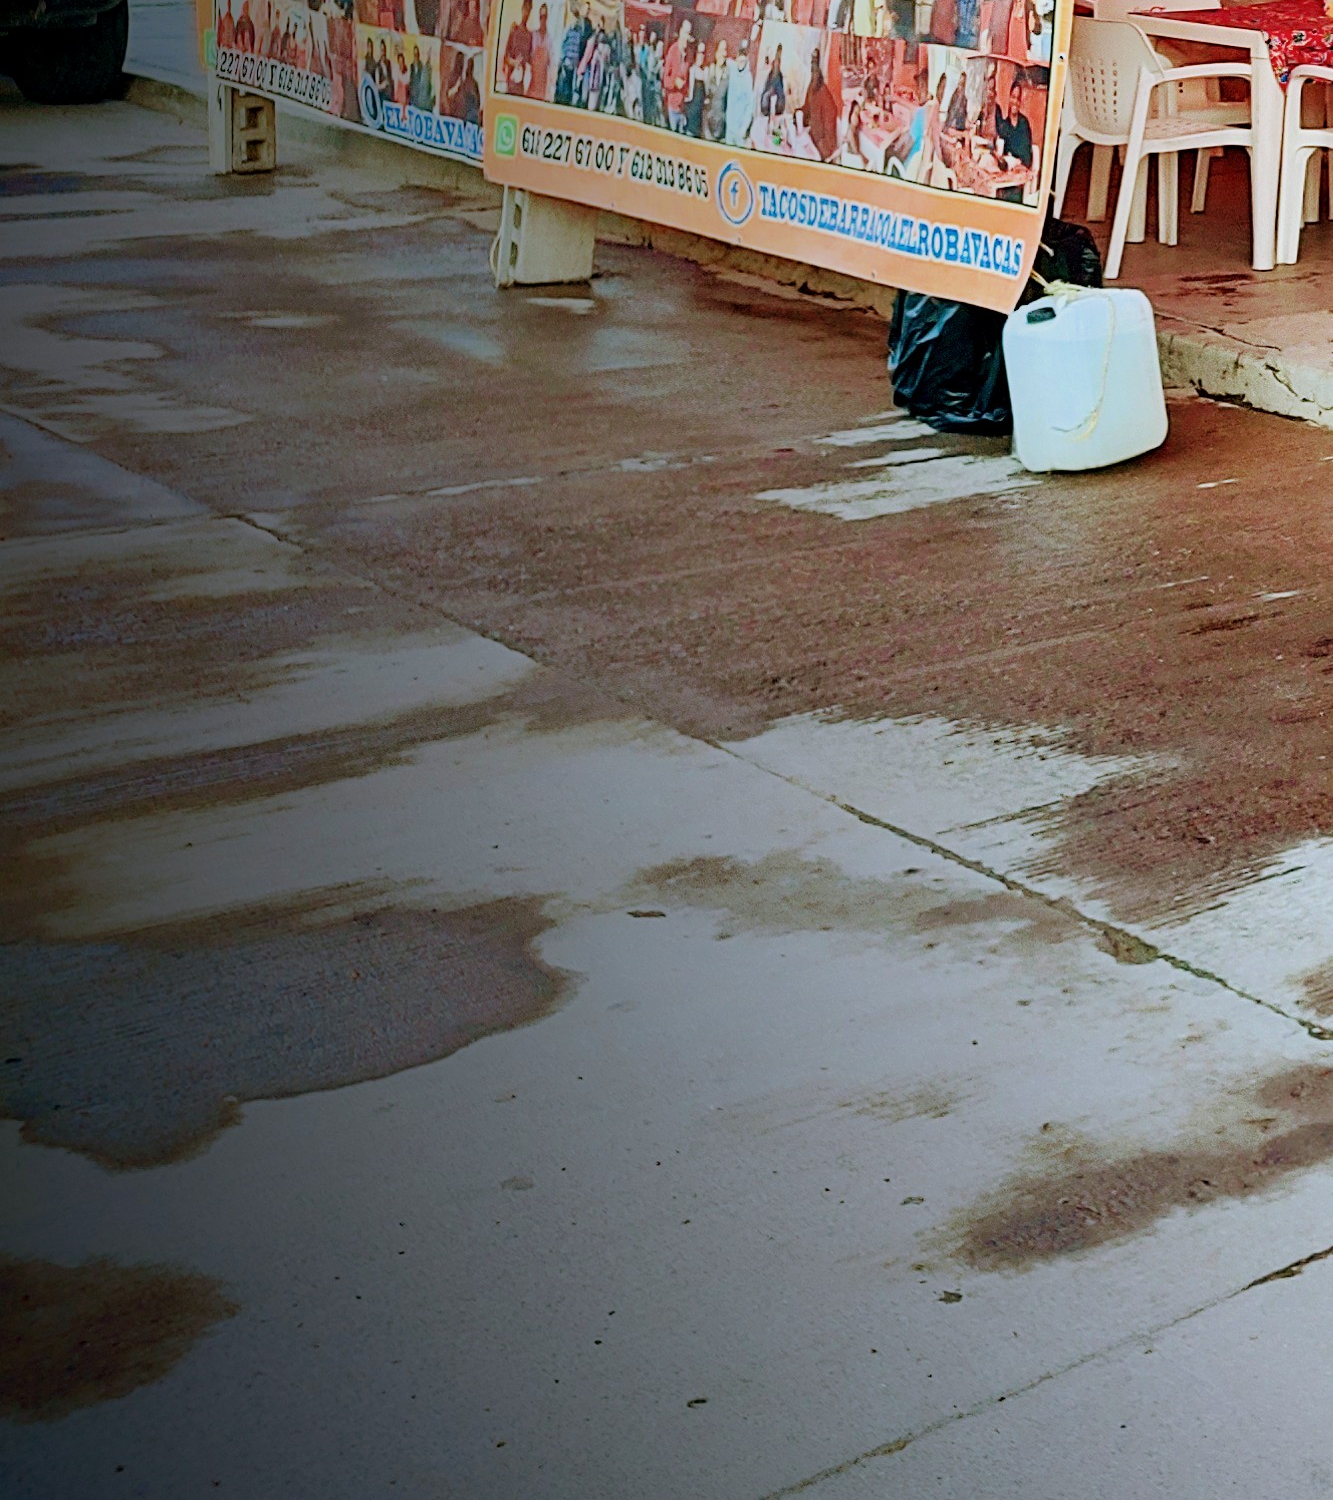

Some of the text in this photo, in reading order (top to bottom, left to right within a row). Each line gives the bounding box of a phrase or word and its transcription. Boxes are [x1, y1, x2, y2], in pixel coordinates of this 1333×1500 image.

[220, 51, 240, 75] 227
[242, 56, 255, 80] 67
[543, 132, 572, 164] 227
[575, 138, 593, 167] 67
[595, 142, 614, 170] 00
[631, 150, 652, 181] 618
[656, 156, 675, 187] 313
[677, 162, 693, 194] 86
